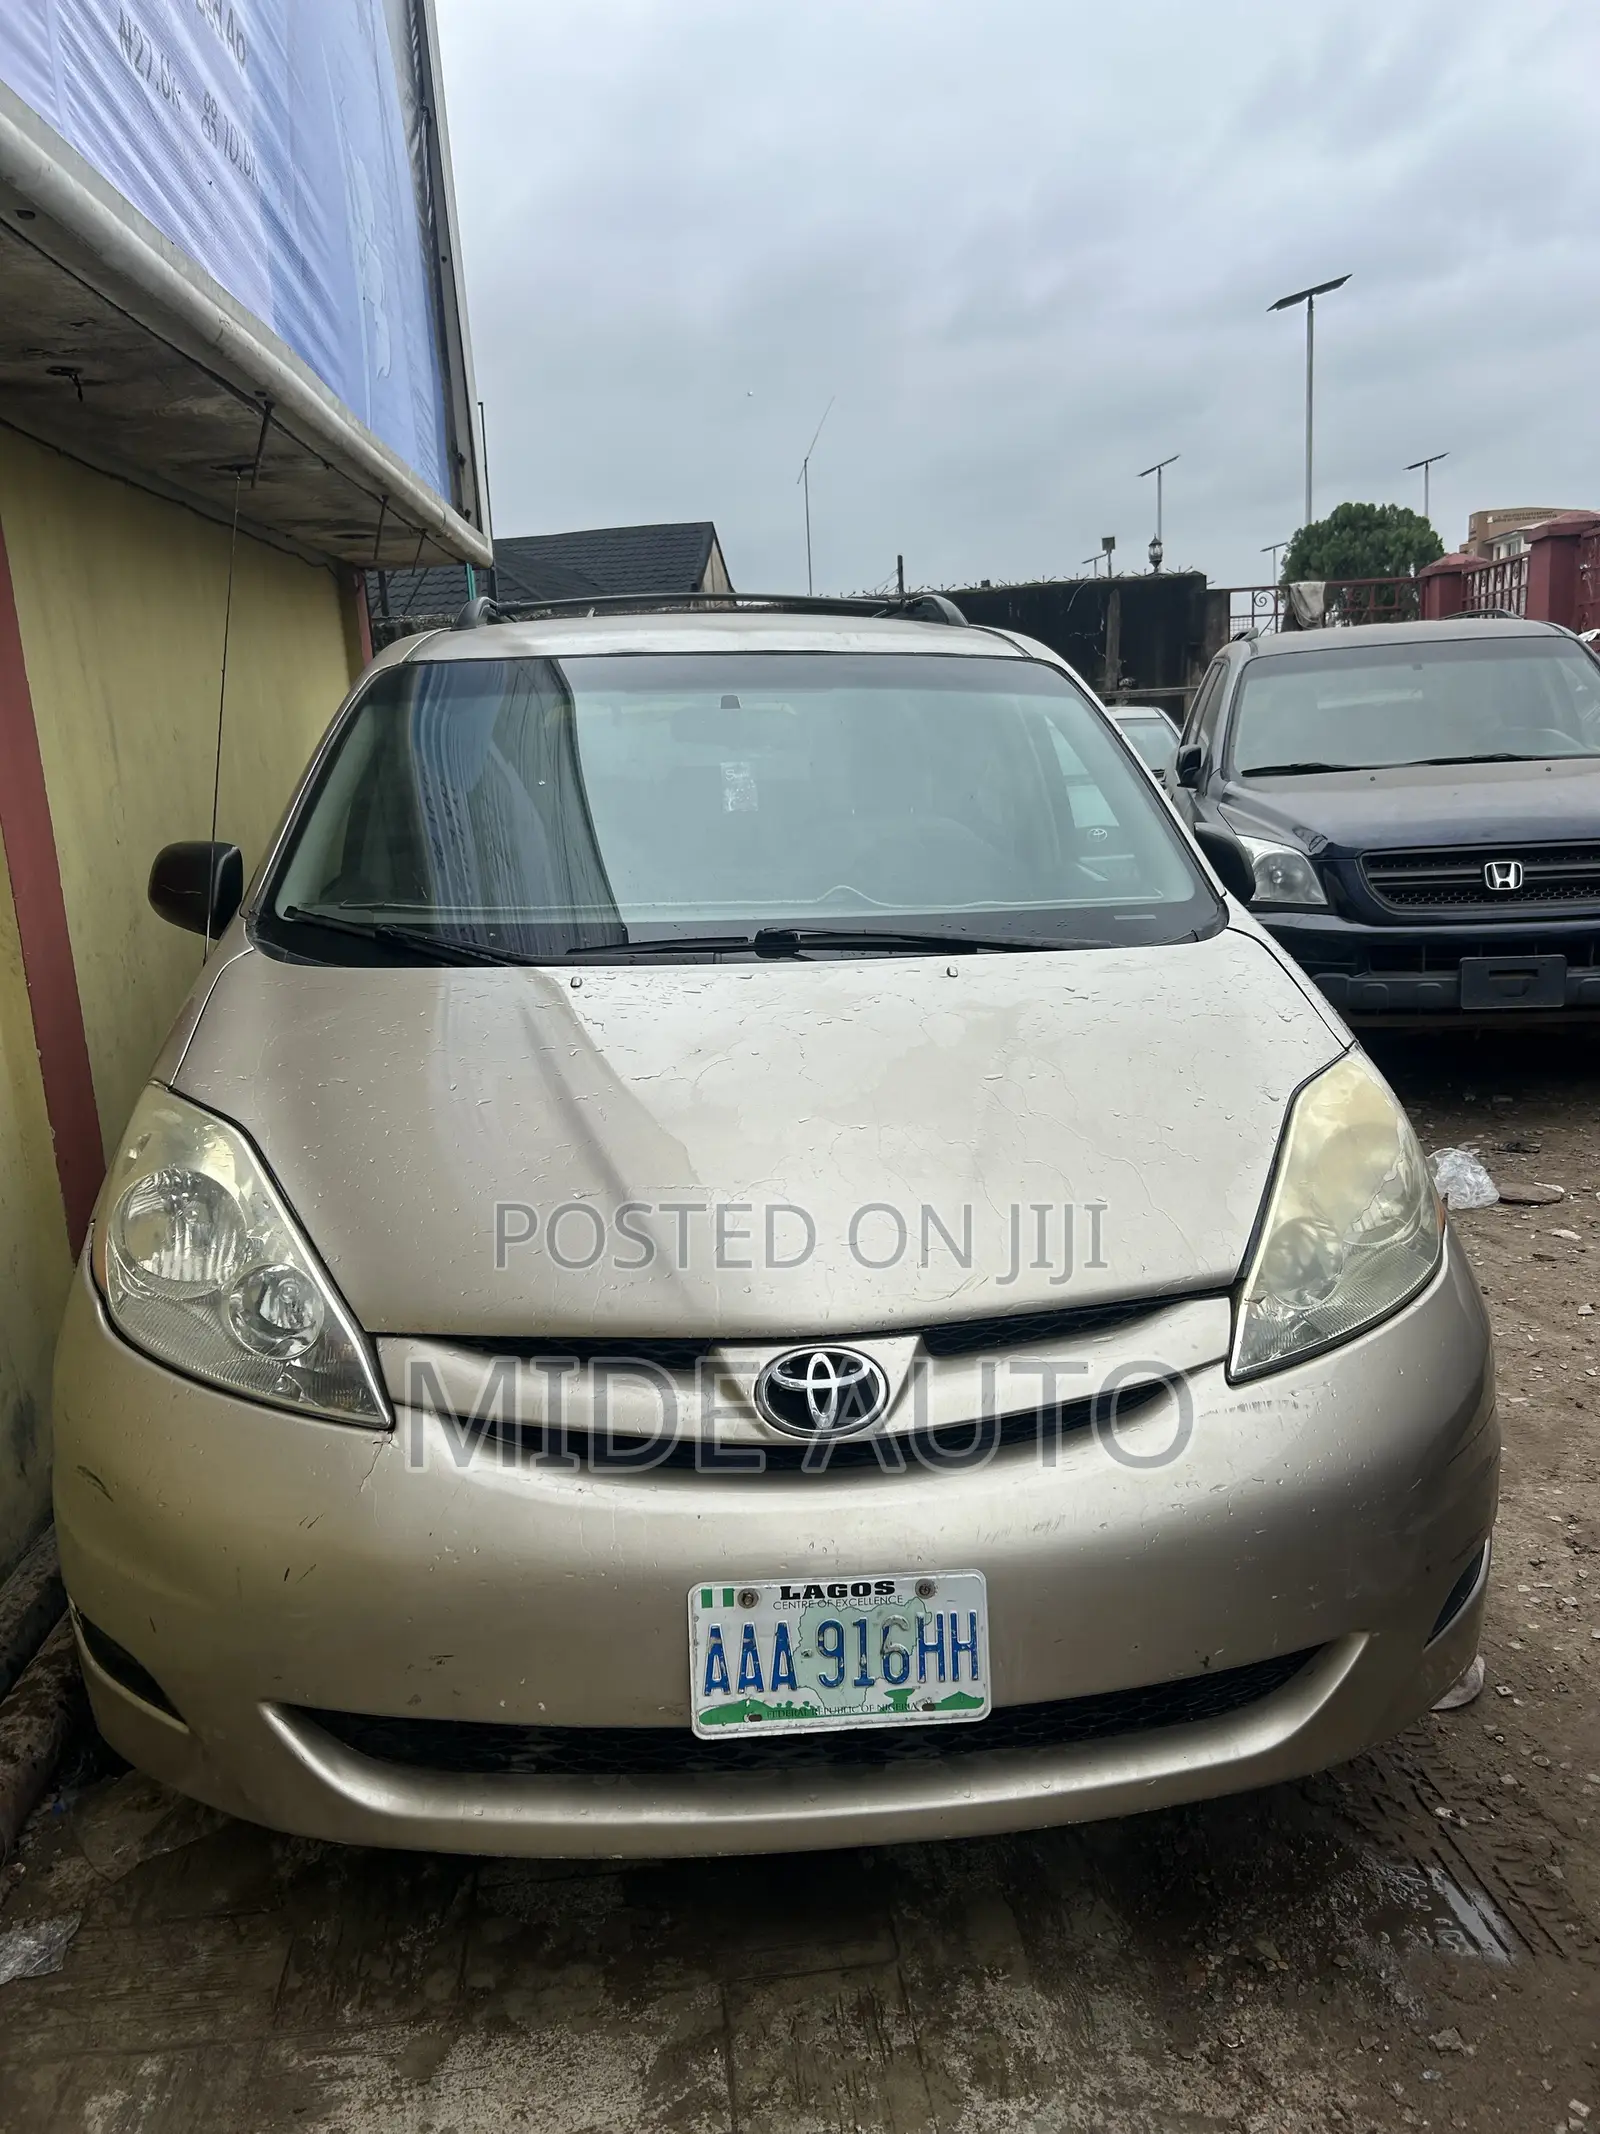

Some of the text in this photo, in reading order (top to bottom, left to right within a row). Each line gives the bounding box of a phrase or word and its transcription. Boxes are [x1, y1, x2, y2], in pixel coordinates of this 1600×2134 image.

[780, 1580, 896, 1600] LAGOS
[773, 1594, 903, 1611] CENTRE OF EXCELLENCE
